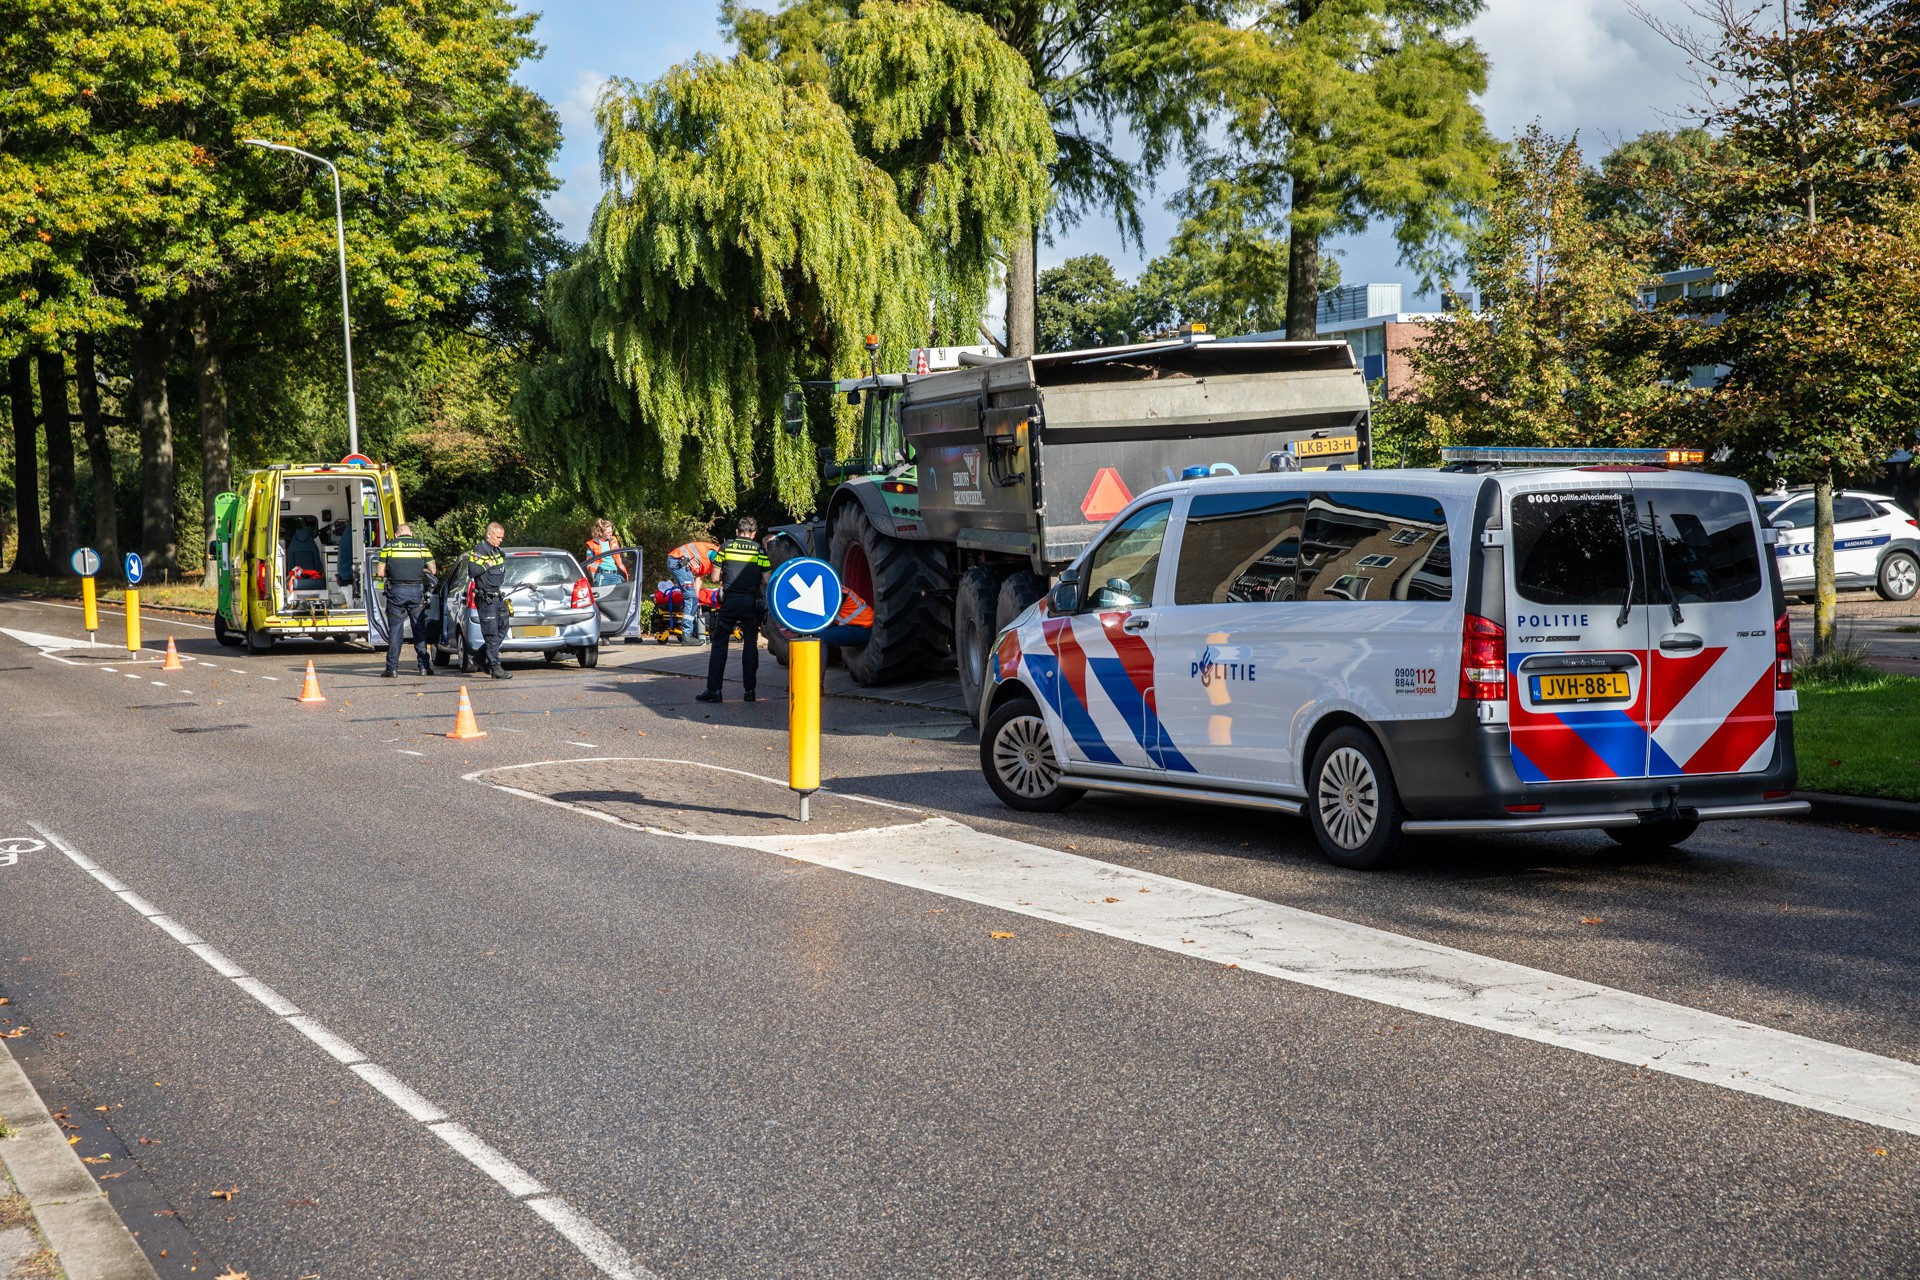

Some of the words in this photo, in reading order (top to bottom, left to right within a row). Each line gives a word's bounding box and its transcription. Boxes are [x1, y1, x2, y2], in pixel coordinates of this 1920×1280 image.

[1300, 439, 1352, 454] LKB-13-H
[1559, 493, 1623, 502] politie.nl/socialmedia
[1844, 539, 1874, 548] HANDHAVING
[1517, 614, 1589, 628] POLITIE
[1395, 668, 1415, 677] 0900
[1416, 669, 1436, 684] 112
[1395, 678, 1416, 687] 8844
[1547, 677, 1623, 697] JVH-88-L
[1416, 685, 1436, 695] spoed
